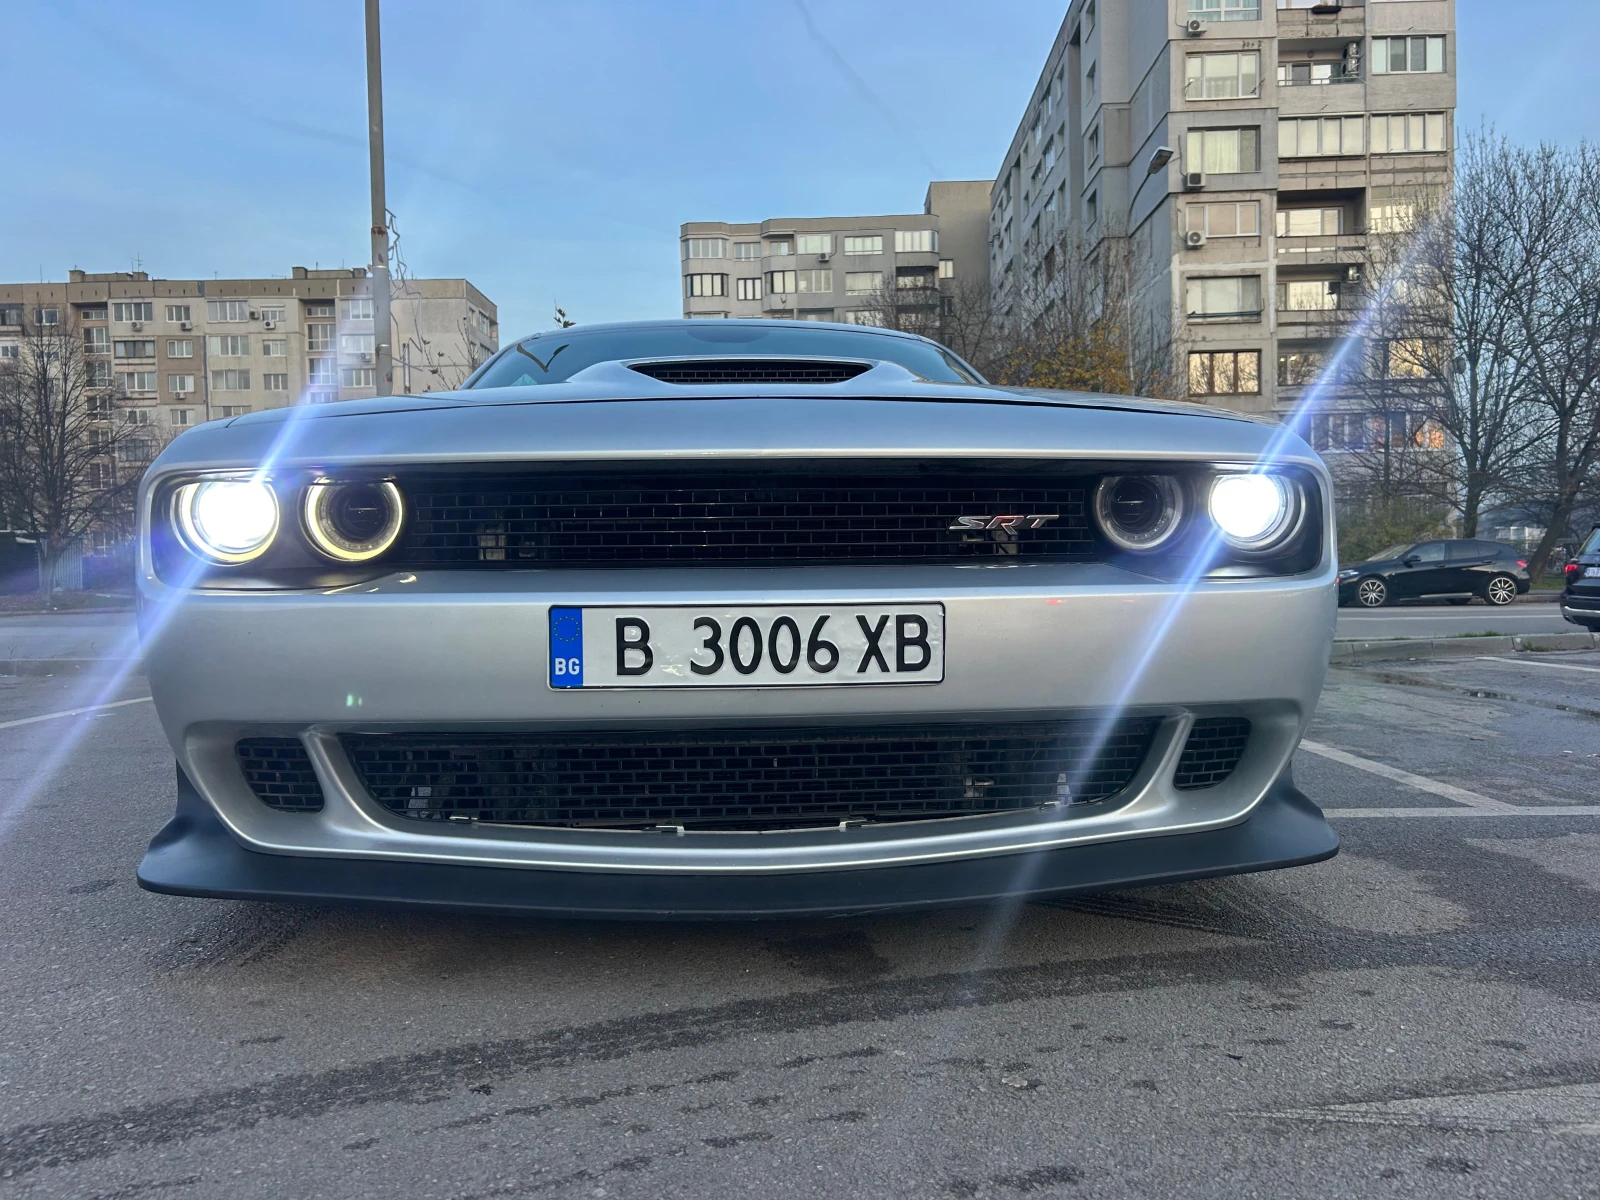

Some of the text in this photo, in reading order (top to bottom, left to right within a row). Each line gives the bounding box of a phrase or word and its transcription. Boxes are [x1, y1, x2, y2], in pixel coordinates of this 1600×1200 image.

[948, 514, 1060, 535] SRT
[615, 614, 932, 676] B 3006 XB
[554, 657, 580, 676] BG
